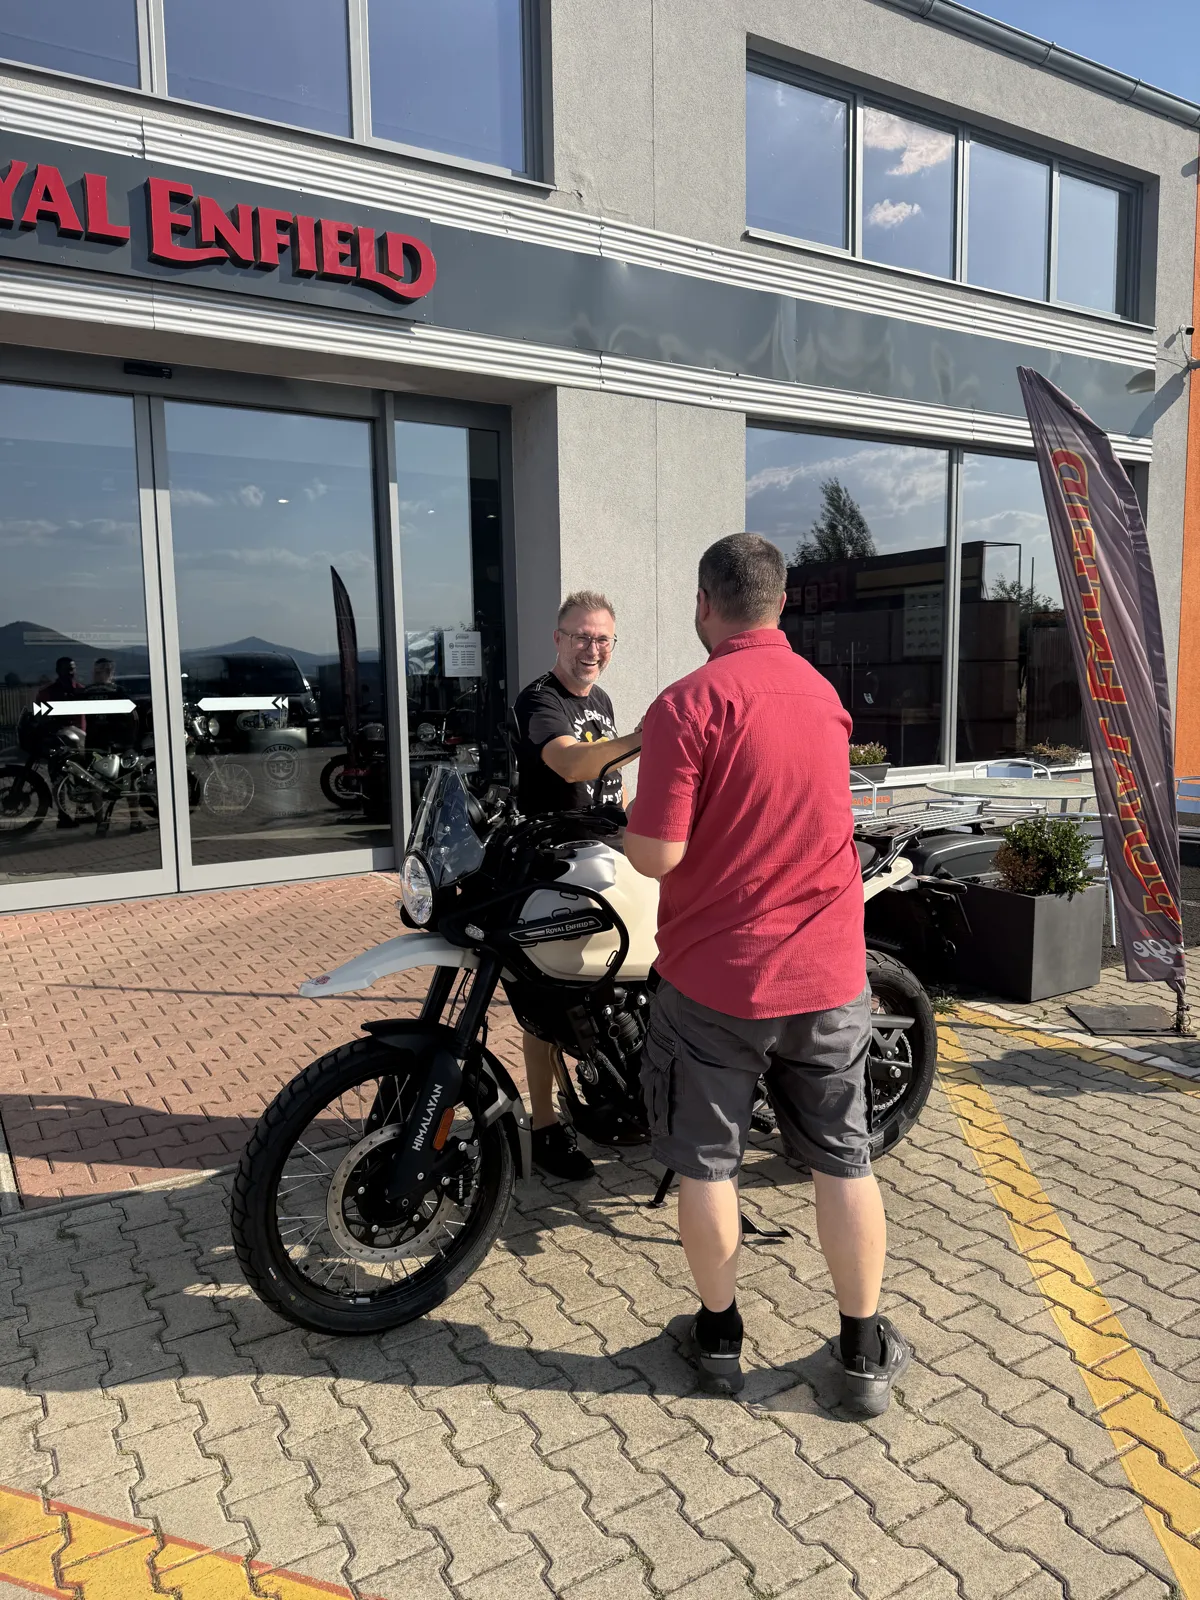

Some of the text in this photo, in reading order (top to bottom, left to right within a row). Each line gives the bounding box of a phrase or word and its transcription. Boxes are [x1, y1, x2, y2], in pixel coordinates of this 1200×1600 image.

[146, 176, 437, 303] ENFIELD
[545, 921, 589, 935] ROYAL ENFIELD
[411, 1083, 443, 1151] HIMALAYAN
